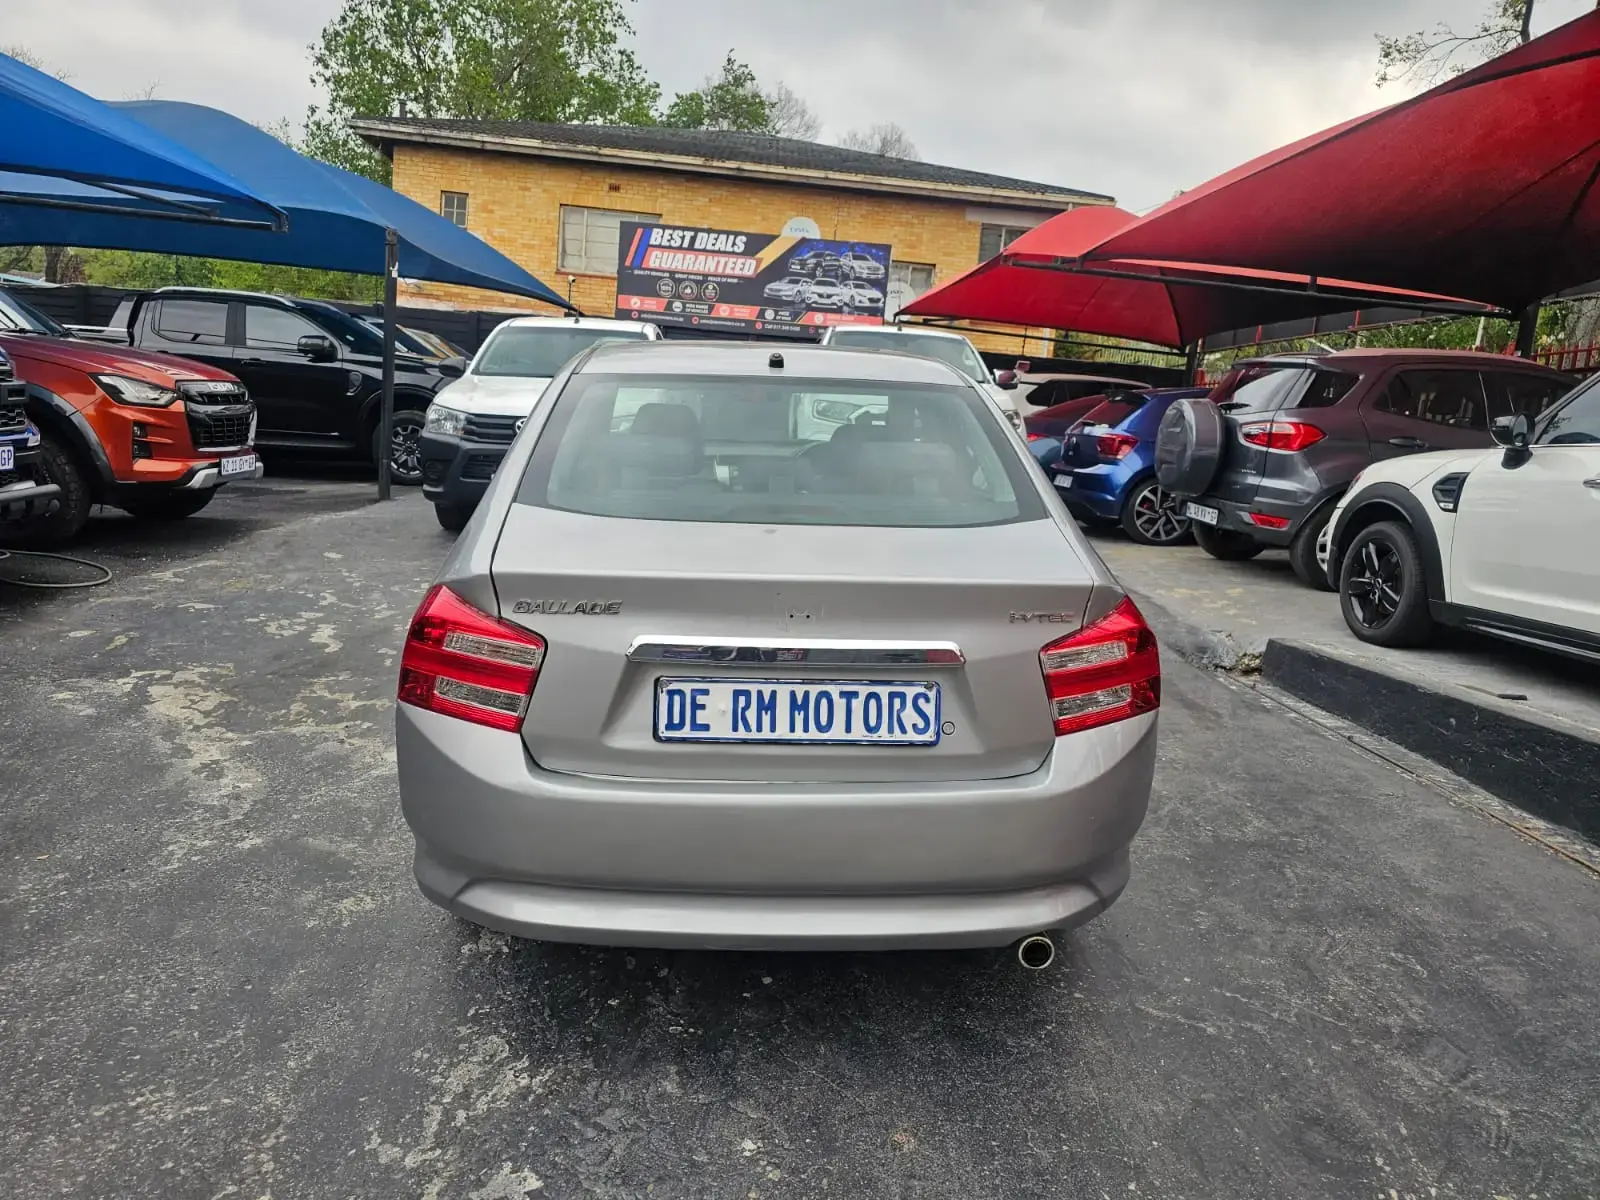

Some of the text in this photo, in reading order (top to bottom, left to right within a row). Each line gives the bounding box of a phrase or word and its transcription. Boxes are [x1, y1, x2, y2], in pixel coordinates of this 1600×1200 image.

[649, 227, 747, 253] BEST DEALS
[648, 250, 757, 275] GUARANTEED
[1, 449, 12, 467] GP
[512, 599, 623, 615] BALLADE
[664, 688, 931, 735] DE RM MOTORS
